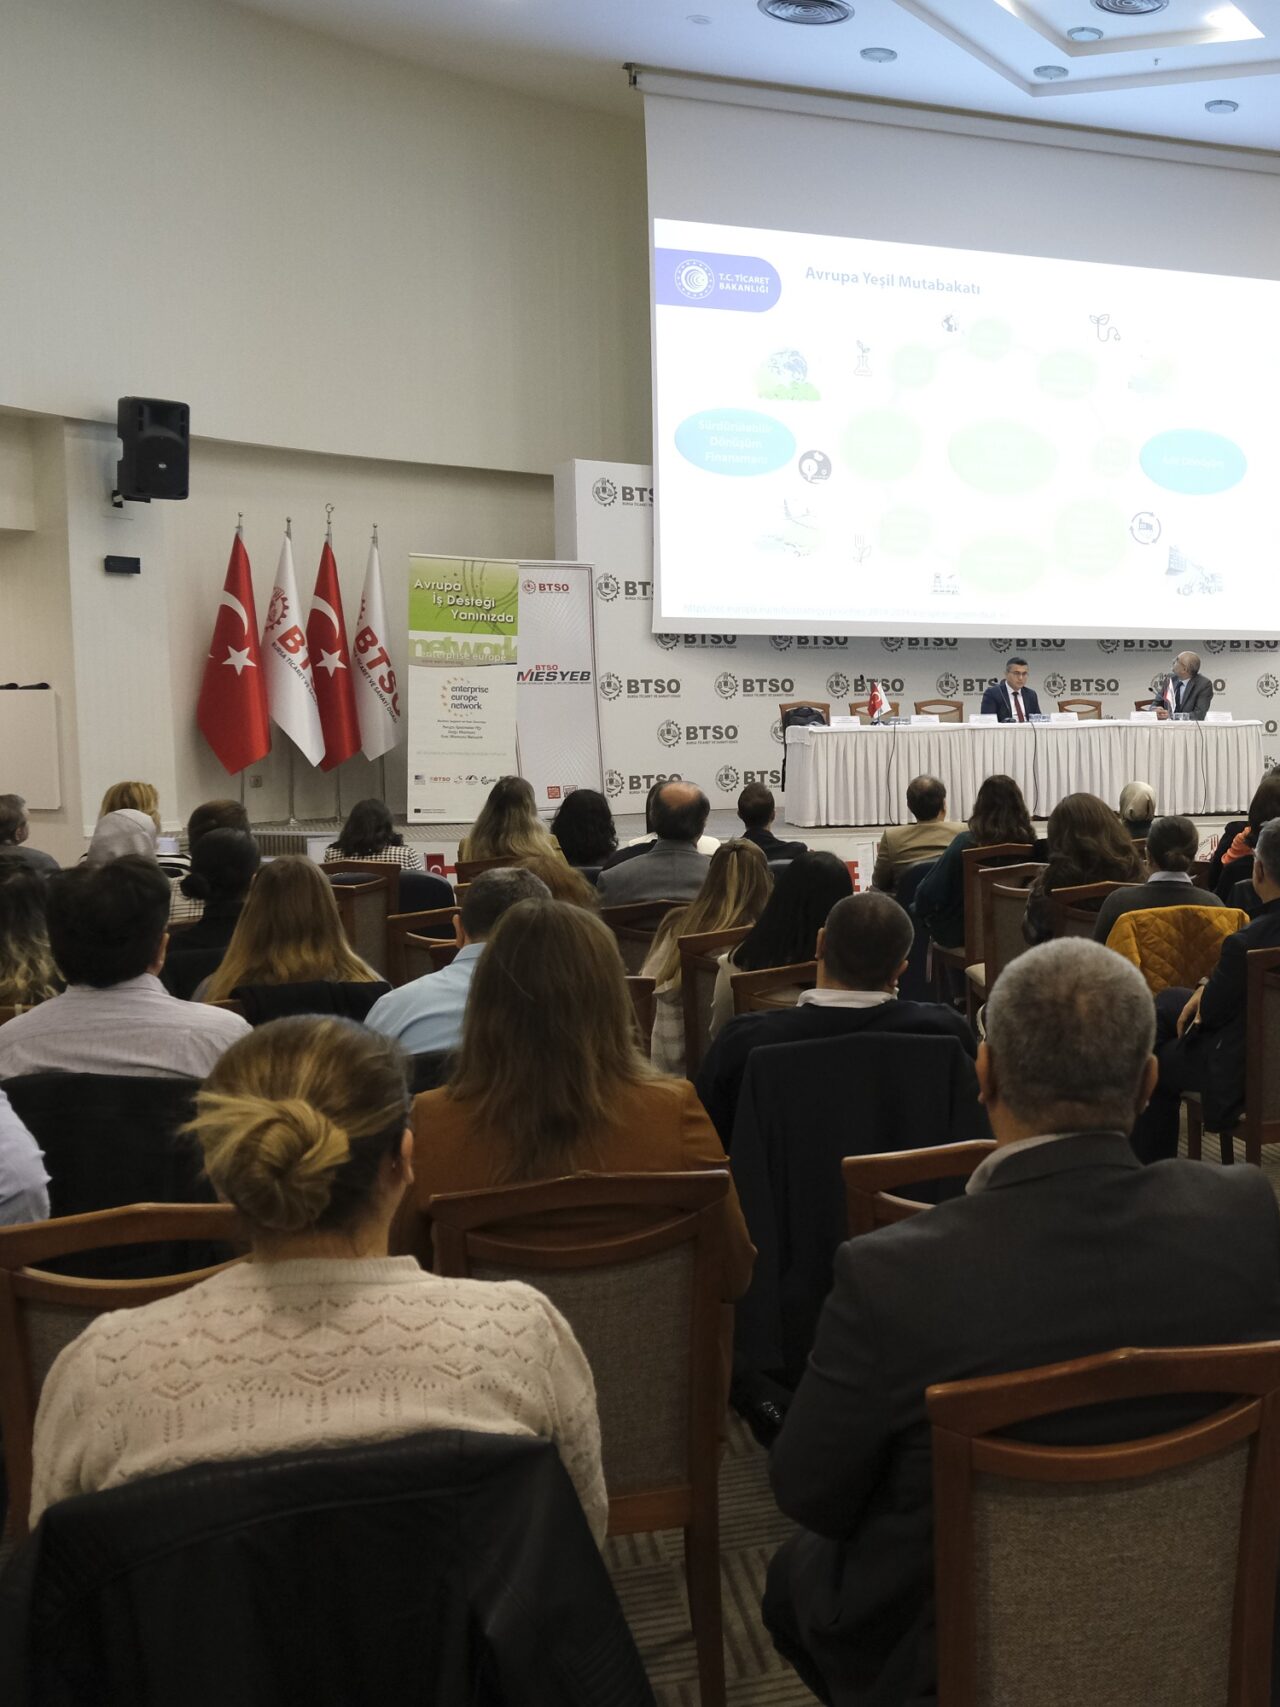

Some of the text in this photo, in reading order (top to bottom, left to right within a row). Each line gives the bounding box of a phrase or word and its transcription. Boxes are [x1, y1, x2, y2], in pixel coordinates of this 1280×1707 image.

[719, 272, 770, 285] T.C. TİCARET
[805, 266, 981, 295] Avrupa Yeşil Mutabakatı
[719, 282, 769, 294] BAKANLIĞI
[622, 486, 654, 502] BT
[414, 578, 462, 592] Avrupa
[538, 583, 570, 592] BTSO
[624, 581, 654, 596] BT
[433, 592, 496, 609] İş Desteği
[451, 609, 514, 622] Yanınızda
[286, 656, 306, 681] TİCARET
[516, 669, 590, 682] MESYEB
[451, 685, 488, 694] enterprise
[626, 679, 681, 694] BTSO
[742, 678, 794, 692] BTSO
[1070, 678, 1119, 692] BTSO
[368, 678, 376, 688] VE
[374, 686, 389, 707] SANAYİ
[451, 702, 482, 710] network
[686, 726, 738, 740] BTSO
[744, 770, 780, 785] BTS
